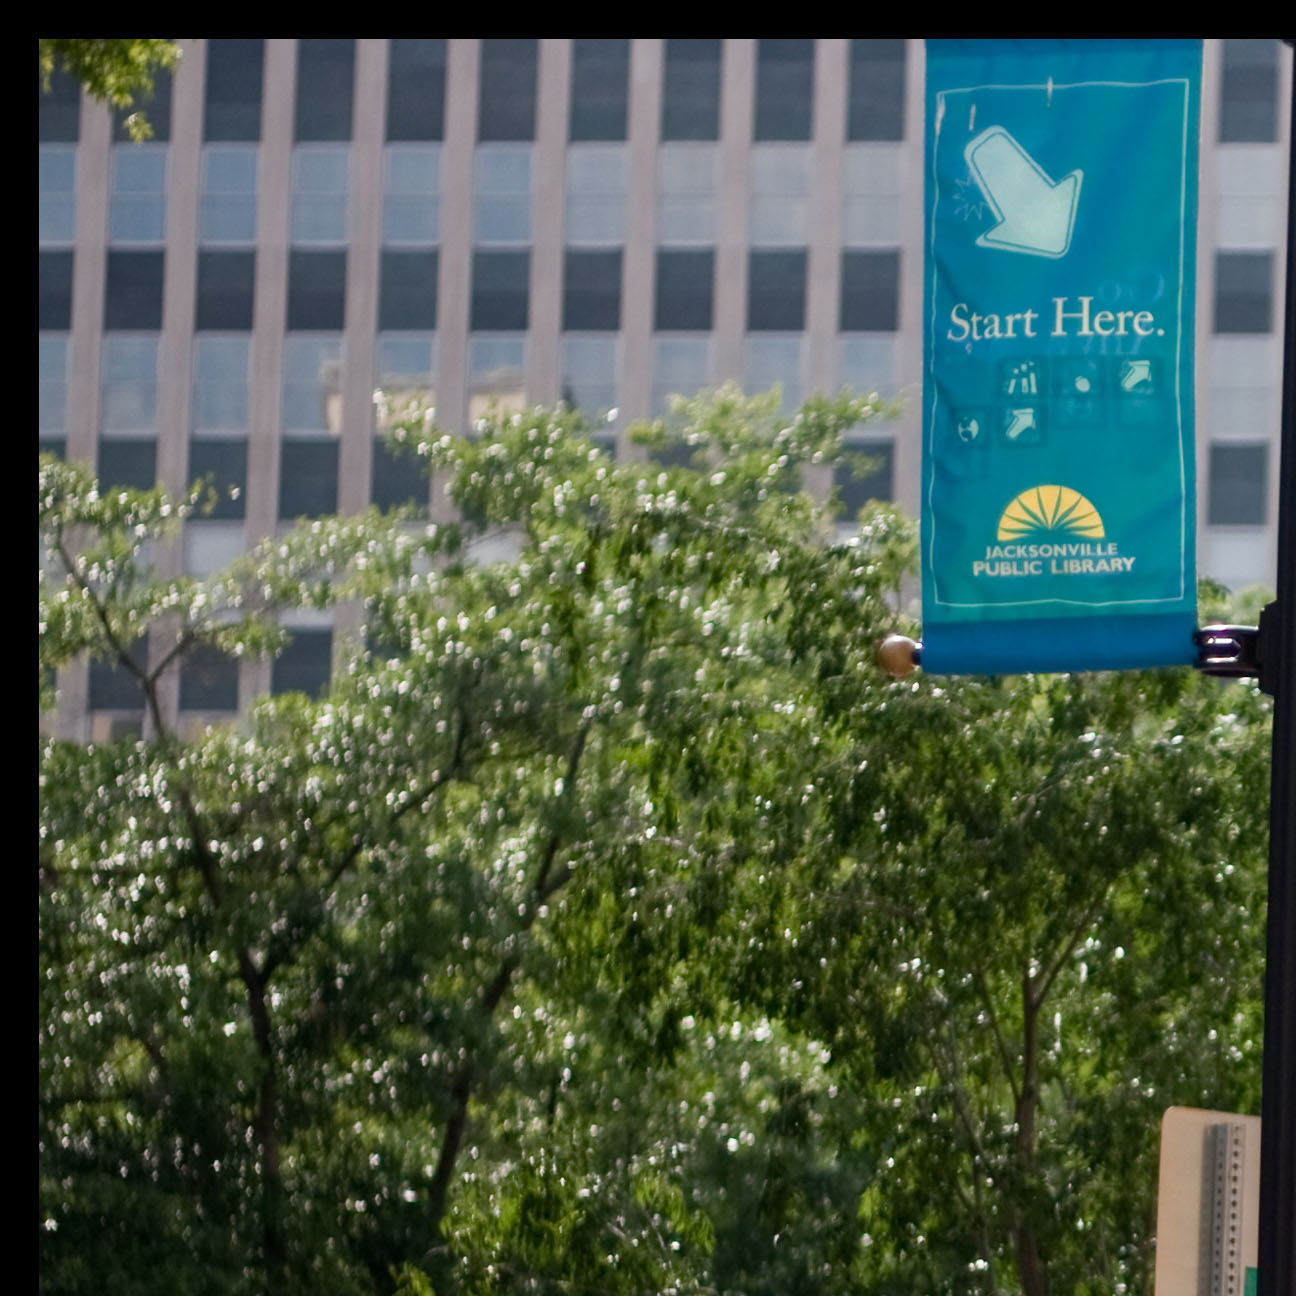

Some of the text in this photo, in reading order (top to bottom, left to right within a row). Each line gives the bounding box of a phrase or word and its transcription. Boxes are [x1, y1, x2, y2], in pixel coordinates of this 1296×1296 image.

[947, 296, 1165, 342] Start Here.
[985, 543, 1119, 560] JACKSONVILLE
[972, 557, 1136, 577] PUBLIC LIBRARY
